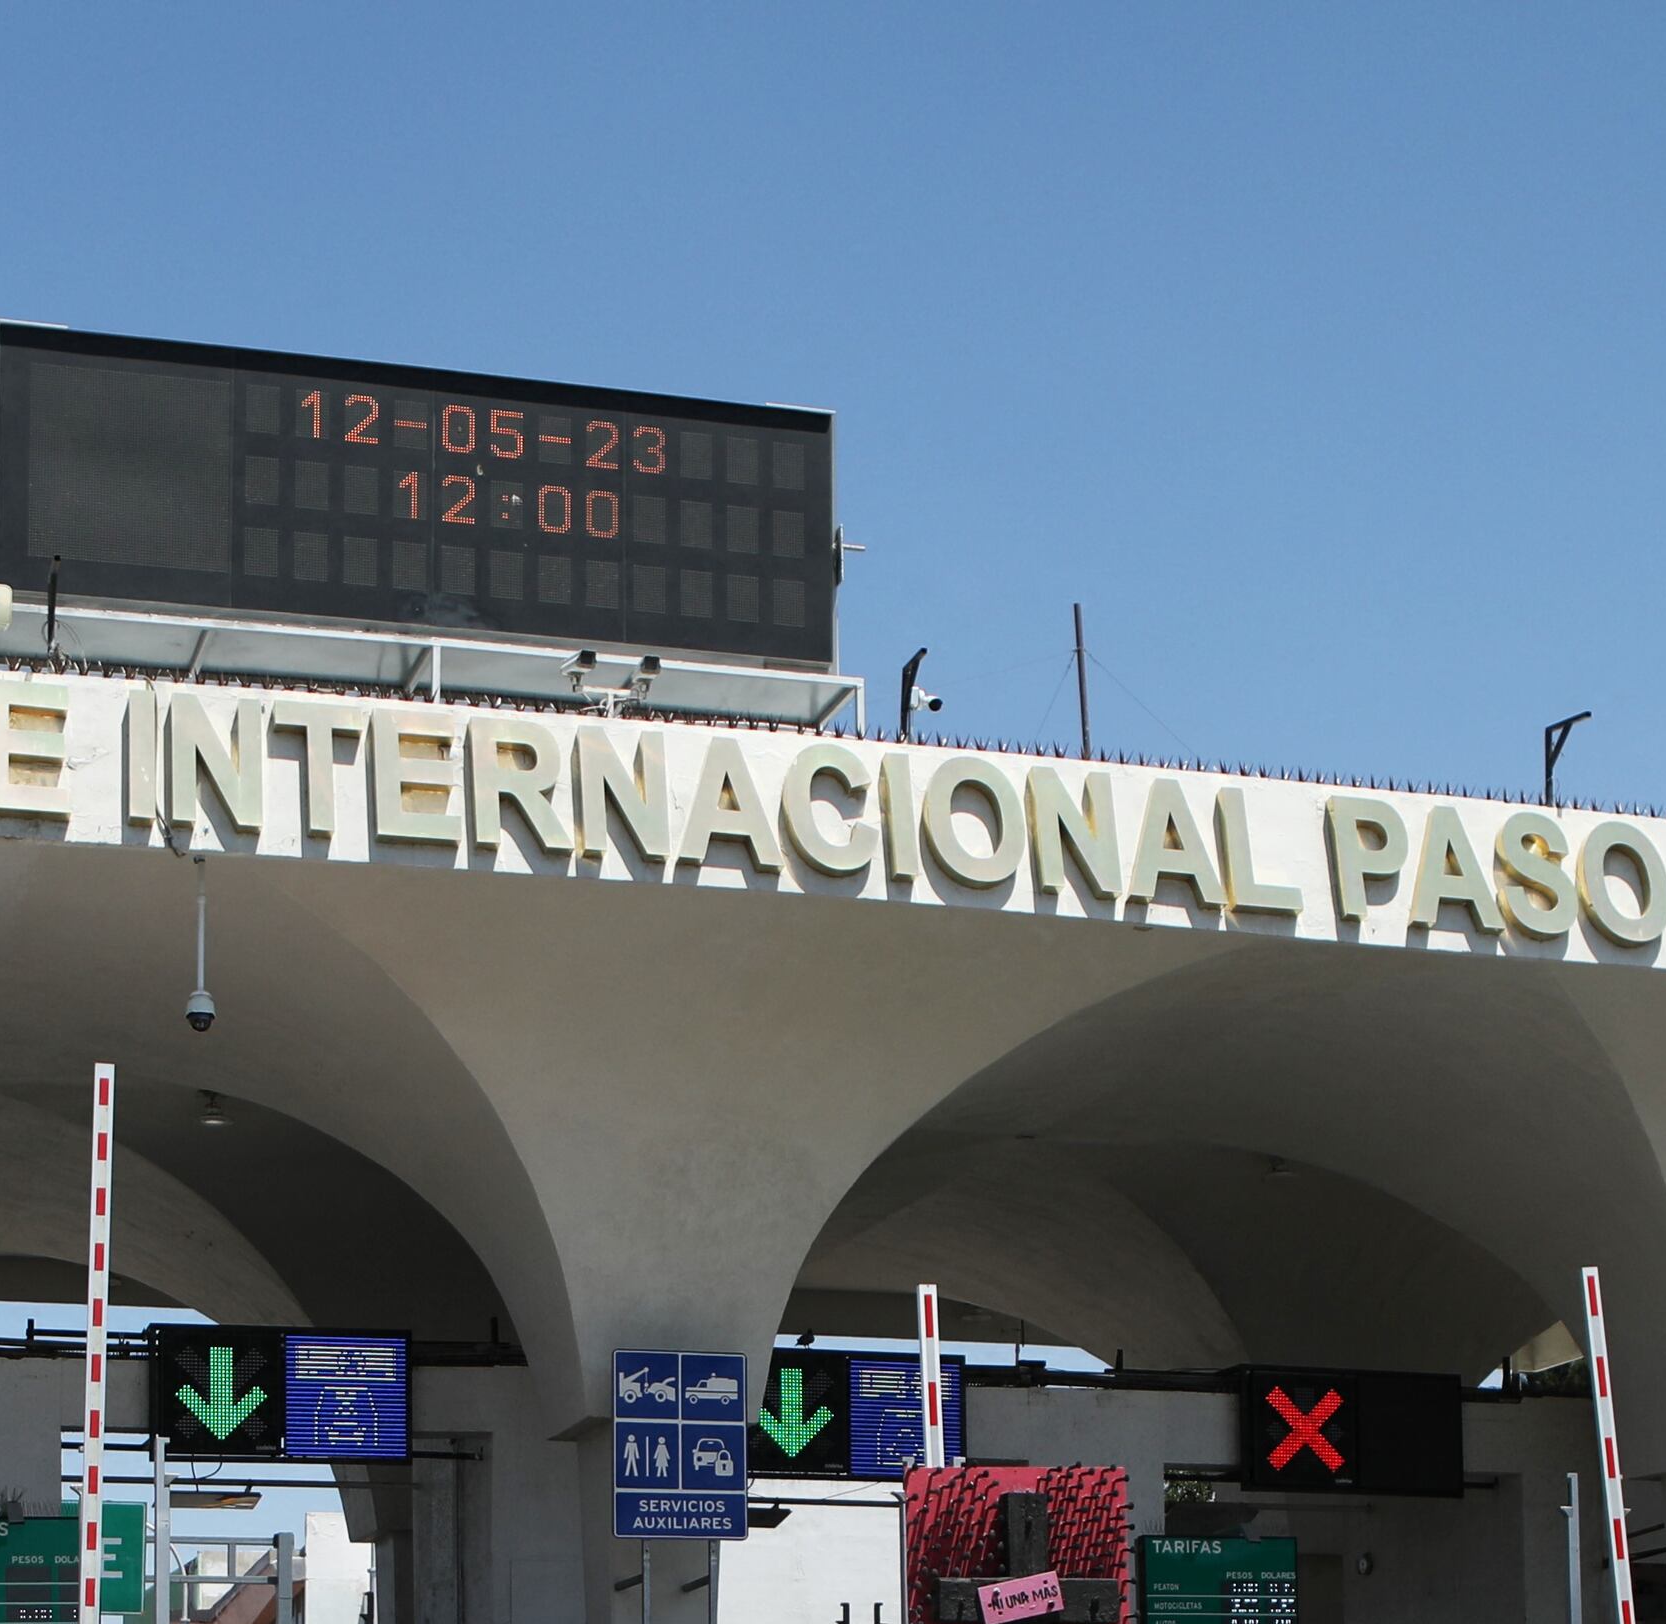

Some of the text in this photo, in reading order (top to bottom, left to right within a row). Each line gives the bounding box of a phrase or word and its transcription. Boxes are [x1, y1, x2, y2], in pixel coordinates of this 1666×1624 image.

[301, 390, 667, 475] 12-05-23
[399, 472, 619, 539] 12:00
[128, 689, 1302, 917] INTERNACIONAL
[639, 1500, 725, 1512] SERVICIOS
[633, 1517, 732, 1529] AUXILIARES
[1152, 1540, 1222, 1554] TARIFAS
[11, 1556, 79, 1564] PESOS DOLA
[1005, 1591, 1029, 1608] UNA
